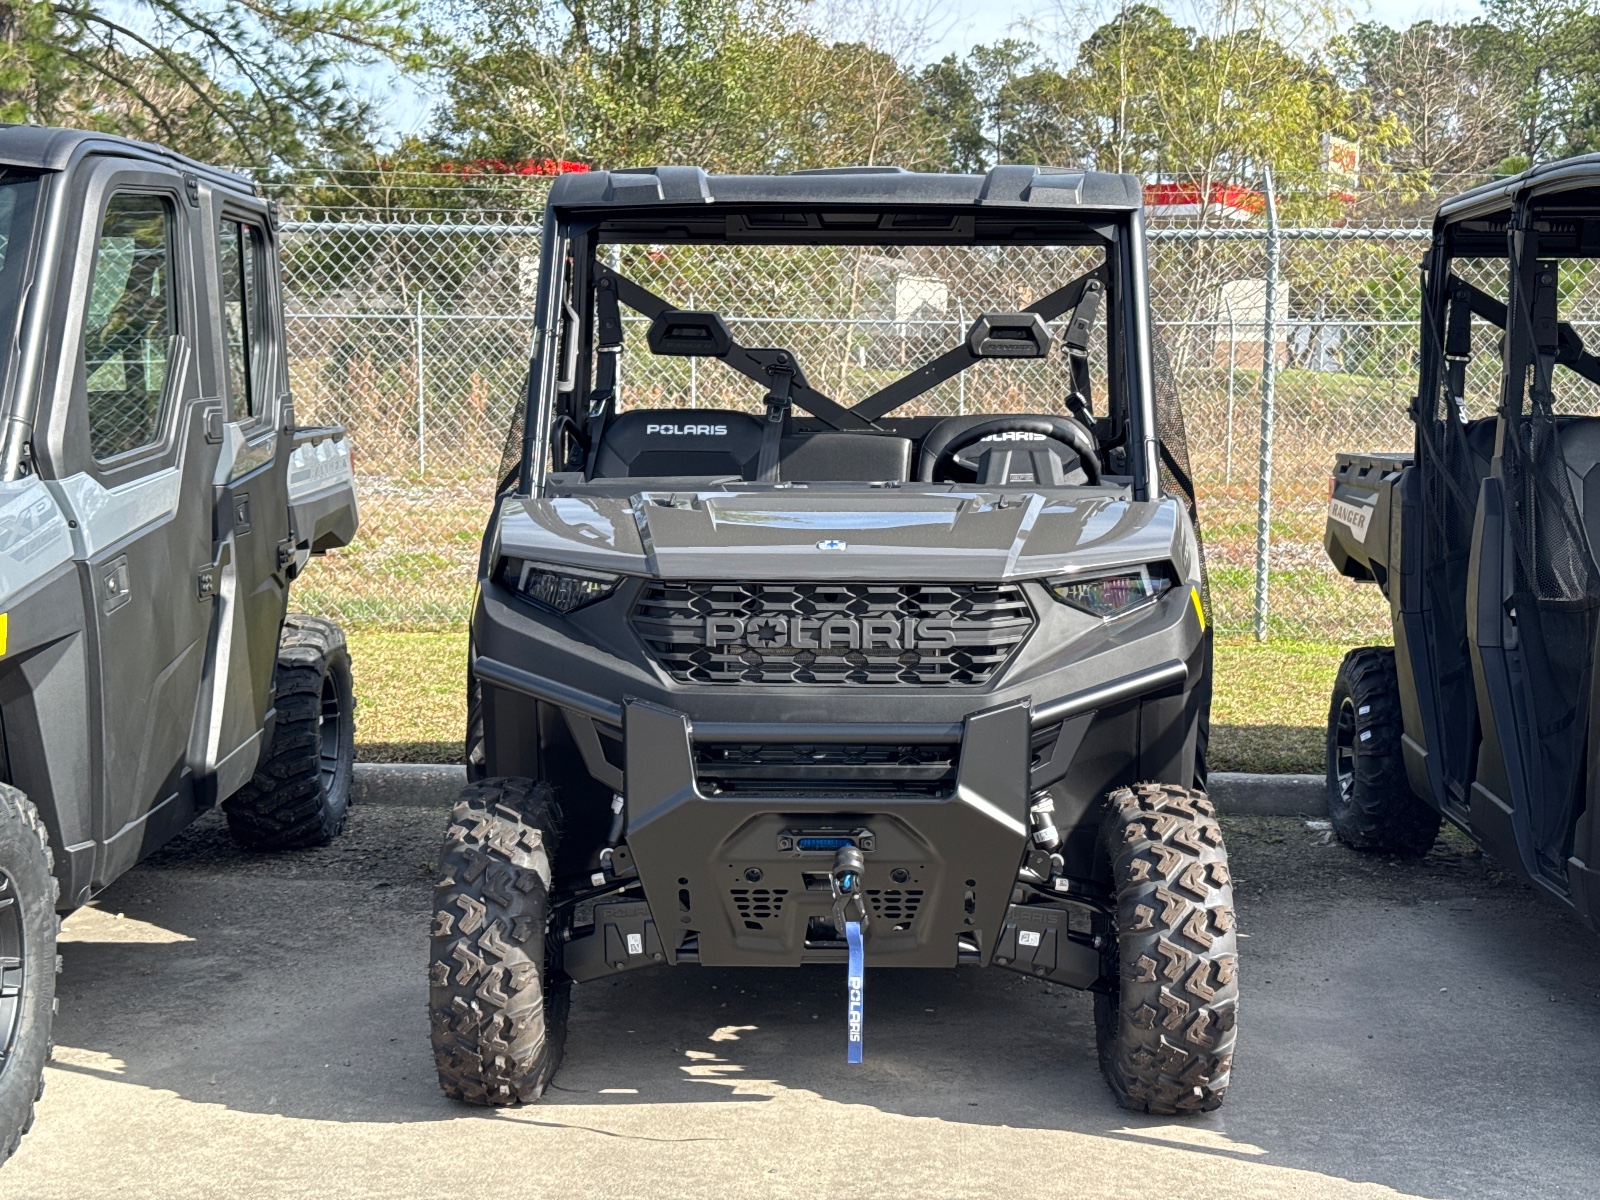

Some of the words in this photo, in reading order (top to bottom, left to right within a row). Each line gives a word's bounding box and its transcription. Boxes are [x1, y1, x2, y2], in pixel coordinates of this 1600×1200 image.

[646, 424, 728, 436] POLARIS
[980, 431, 1047, 442] LARIS
[310, 456, 348, 480] RANGER
[1332, 503, 1366, 528] RANGER
[706, 616, 956, 650] POLARIS
[849, 976, 861, 1042] POLARIS
